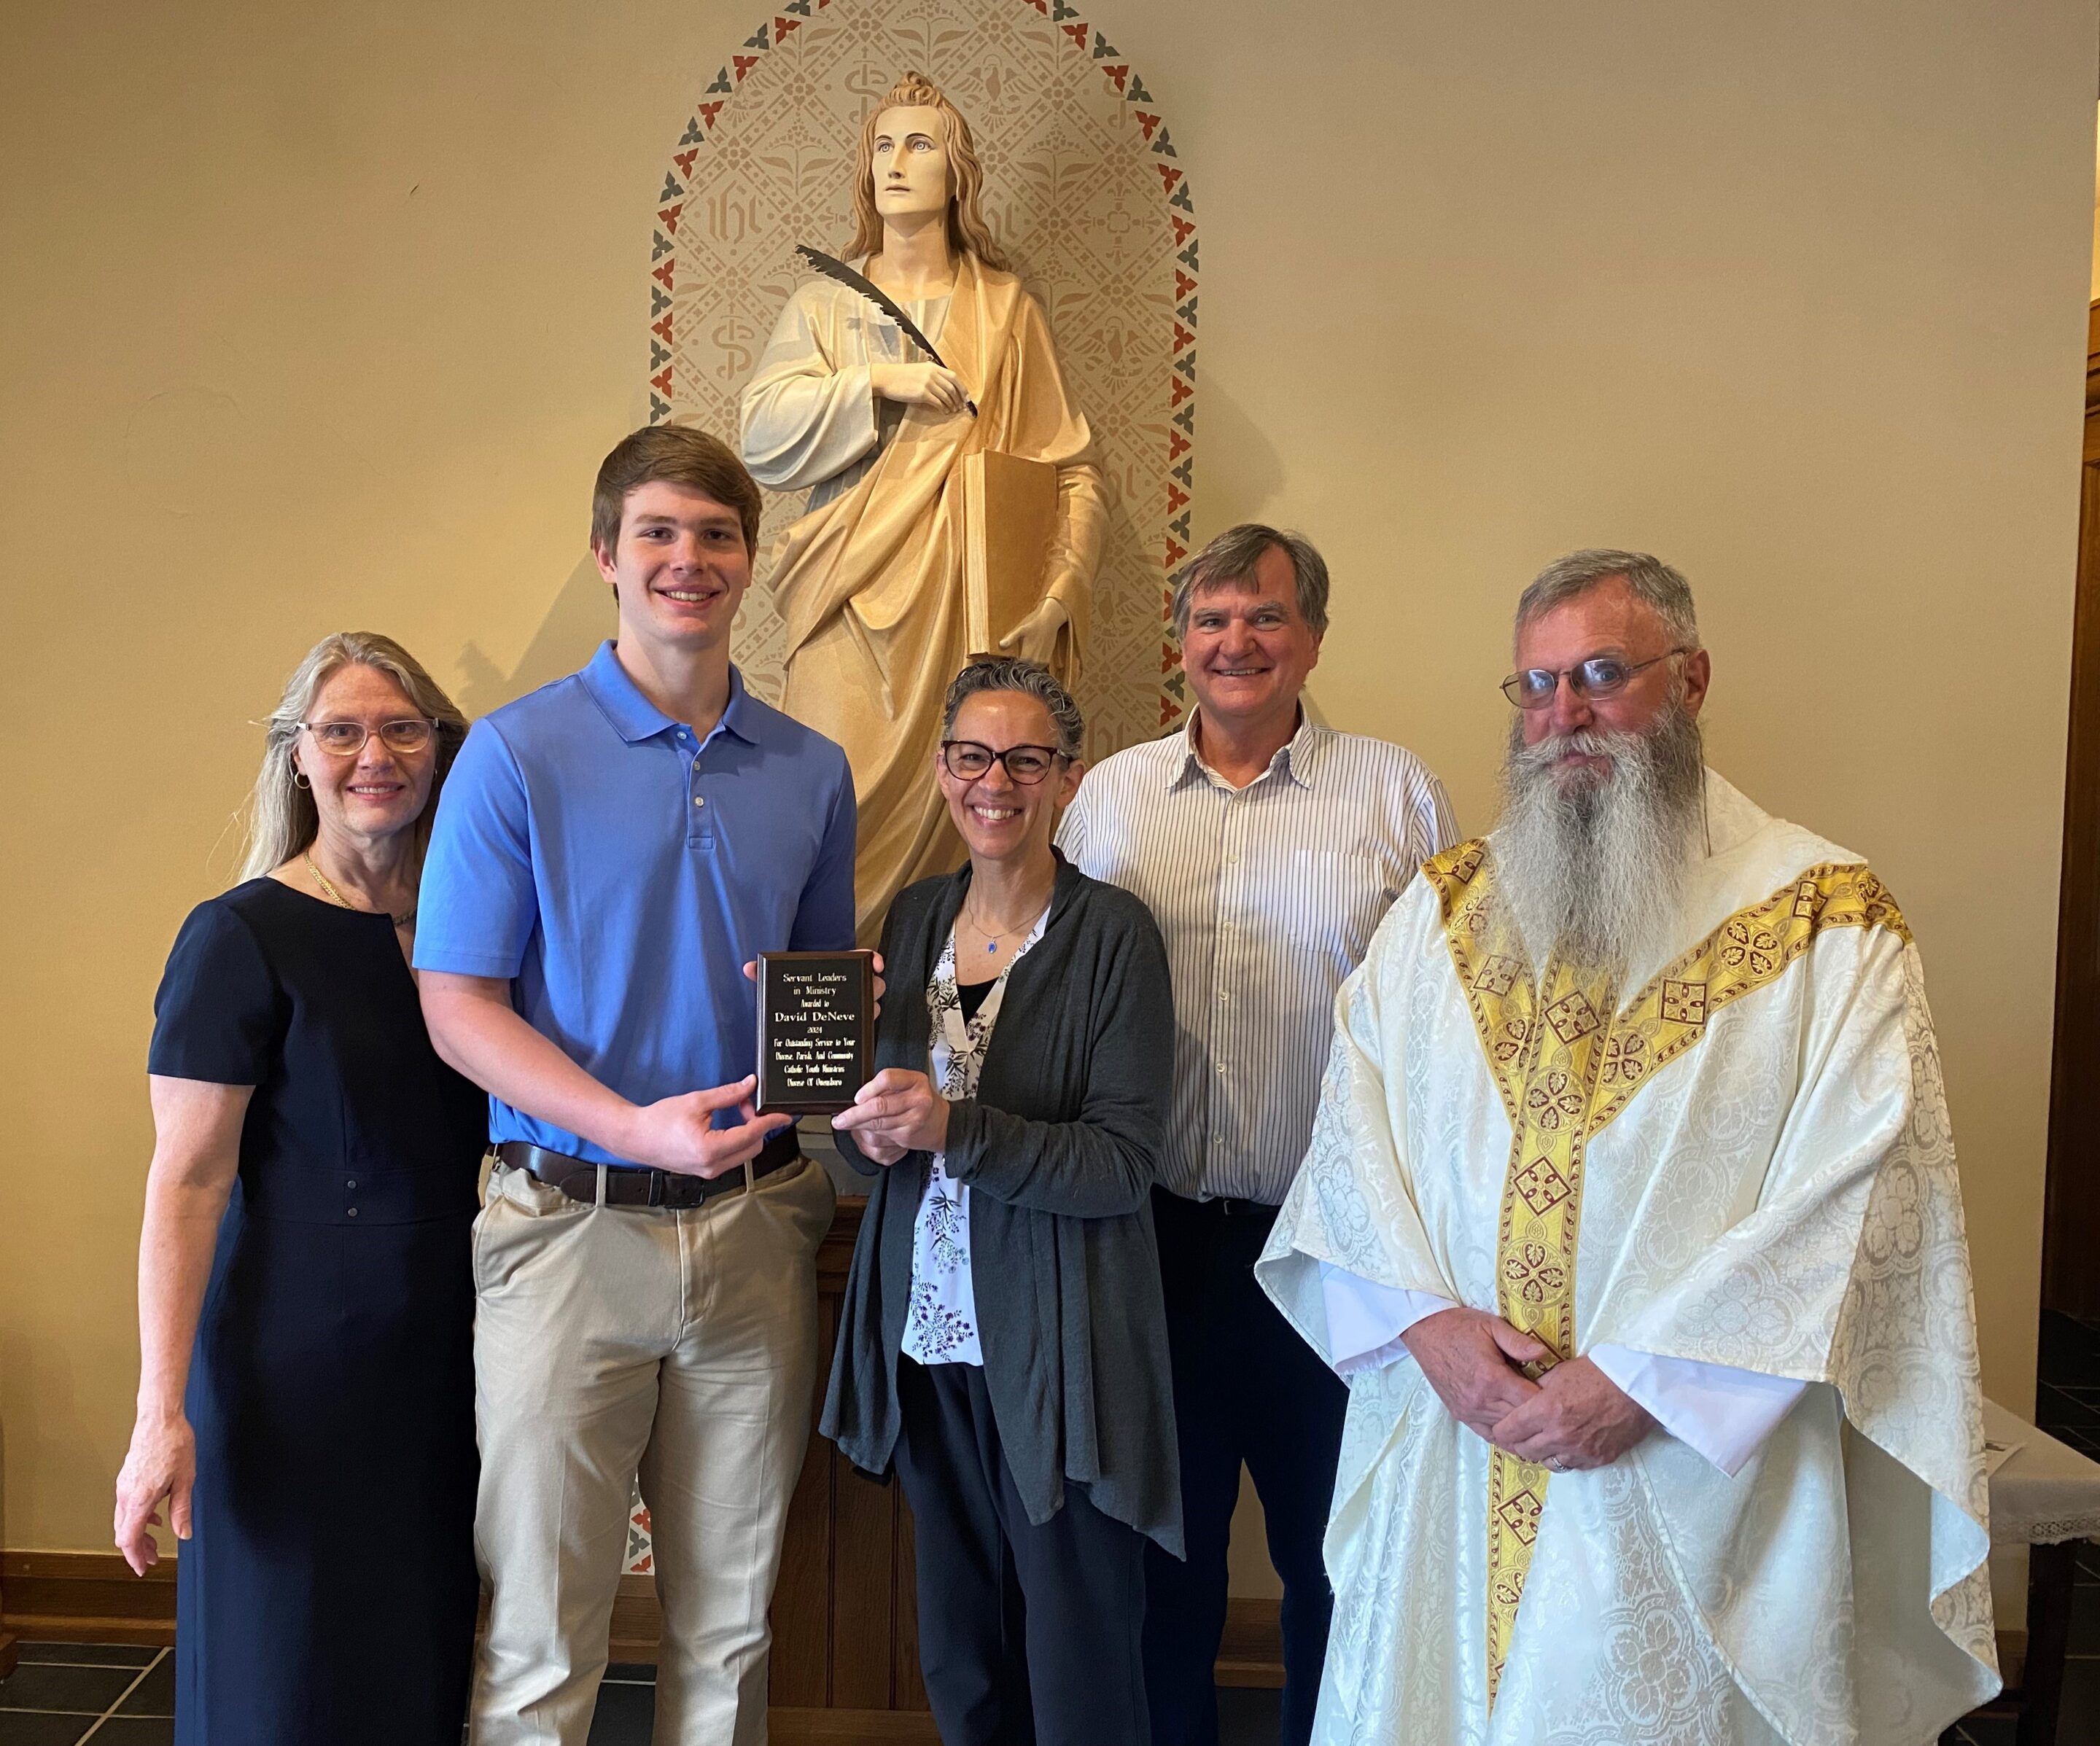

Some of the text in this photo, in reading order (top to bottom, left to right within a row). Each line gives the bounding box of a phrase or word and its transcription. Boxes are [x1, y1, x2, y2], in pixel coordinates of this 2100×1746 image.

[783, 973, 847, 982] Servant Leaders
[793, 986, 836, 996] in Ministry
[801, 999, 822, 1008] Awarded
[774, 1011, 855, 1021] David DeNeve
[774, 1037, 856, 1048] For Outstanding Service to Your
[784, 1064, 803, 1074] Catholic
[806, 1064, 820, 1073] Youth
